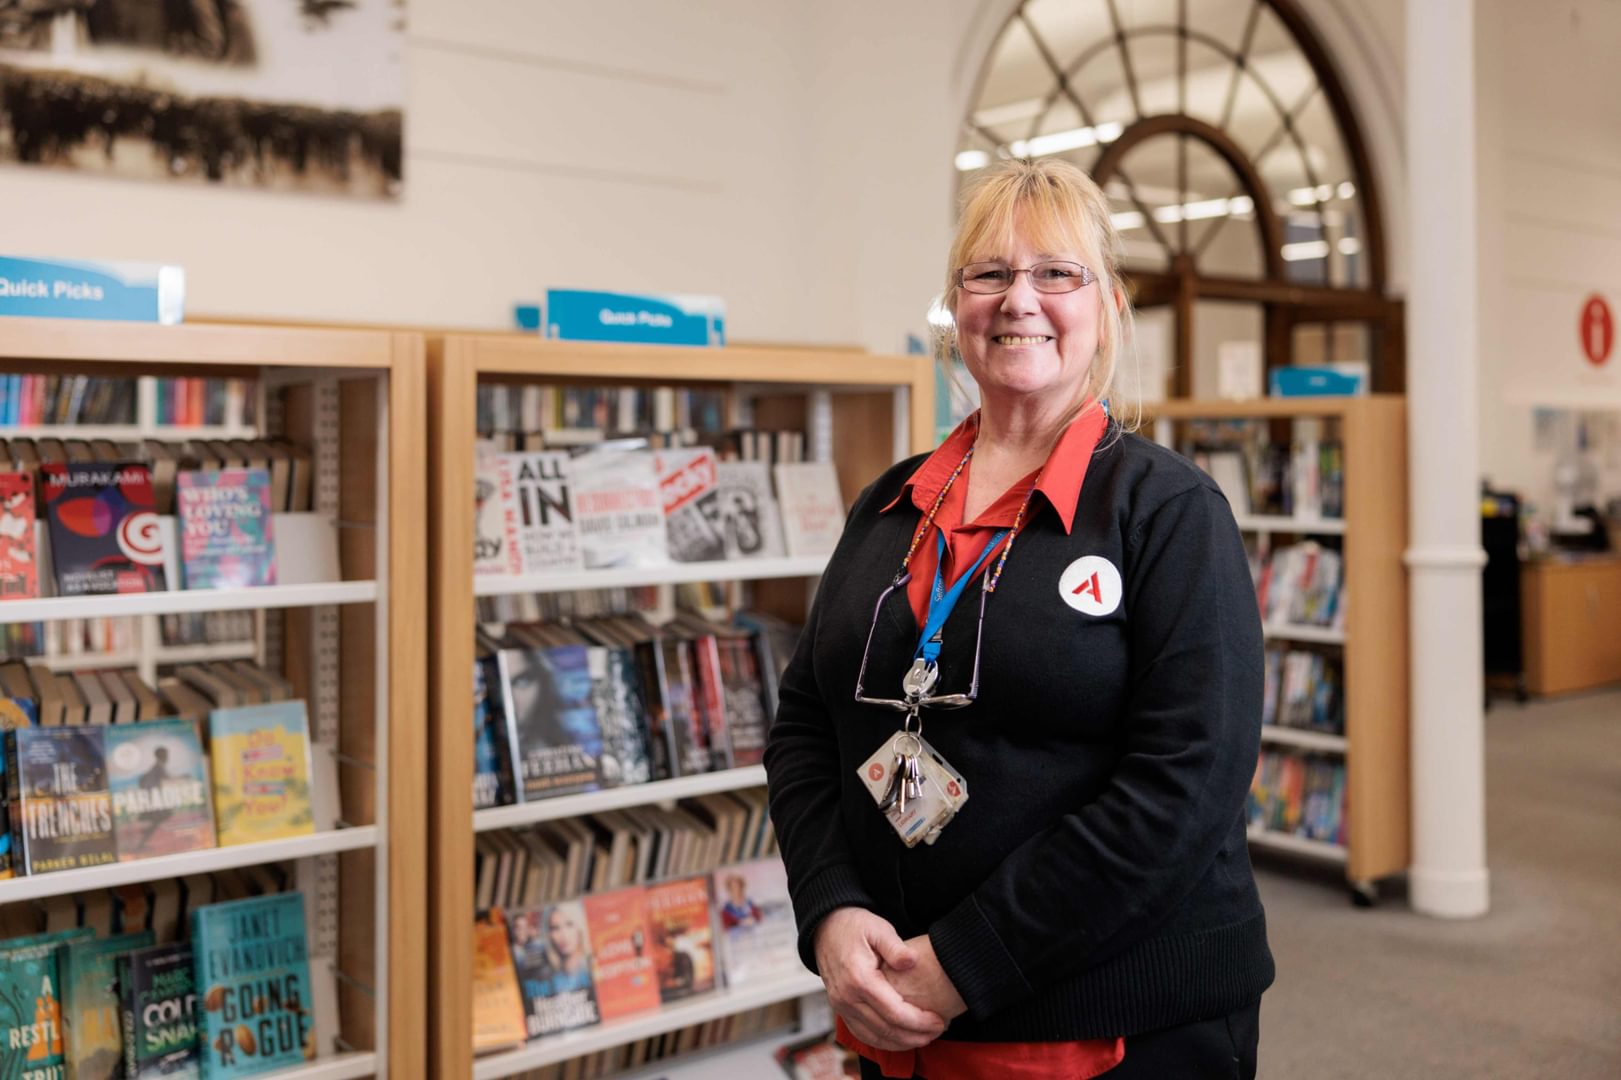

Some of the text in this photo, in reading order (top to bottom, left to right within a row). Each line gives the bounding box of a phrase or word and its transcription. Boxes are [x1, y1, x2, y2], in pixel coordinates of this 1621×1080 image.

[0, 278, 104, 301] Quick Picks
[49, 471, 145, 488] MURAKAMI
[518, 457, 567, 481] ALL
[184, 503, 262, 520] LOVING
[519, 484, 573, 527] IN
[184, 518, 231, 537] YOU
[53, 761, 78, 795] THE
[113, 779, 205, 817] PARADISE
[28, 799, 113, 840] TRENCHES
[32, 852, 115, 872] PARKER BILAL
[229, 908, 280, 942] JANET
[208, 937, 306, 980] EVANOVICH
[41, 974, 54, 998] A
[222, 974, 300, 1023] GOING
[9, 1019, 60, 1050] RESTL
